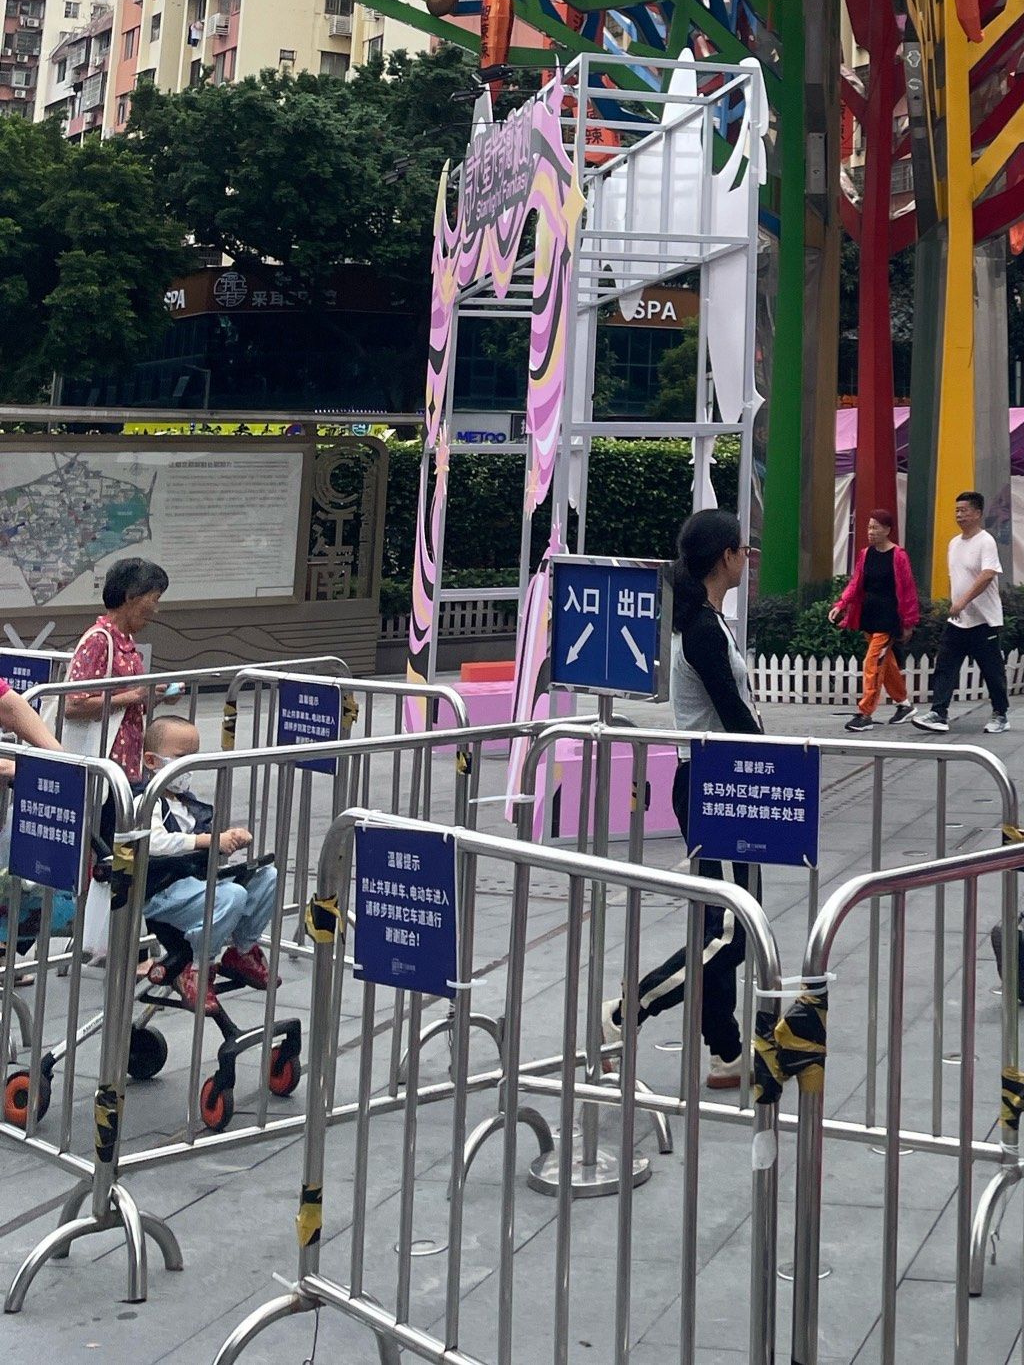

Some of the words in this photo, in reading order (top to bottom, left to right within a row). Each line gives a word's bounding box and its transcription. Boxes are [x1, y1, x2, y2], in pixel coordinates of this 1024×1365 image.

[634, 299, 677, 321] SPA
[563, 585, 600, 615] 入口
[617, 588, 656, 619] 出口
[733, 760, 775, 775] 温馨提示
[37, 777, 60, 795] 温馨提示
[703, 782, 806, 802] 铁马外区域严禁停车
[702, 801, 805, 823] 违规乱停放锁车处理
[387, 850, 421, 872] 温馨提示
[361, 877, 450, 907] 禁止共享单车、电动车进入
[365, 900, 443, 929] 请移步到其它车道通行
